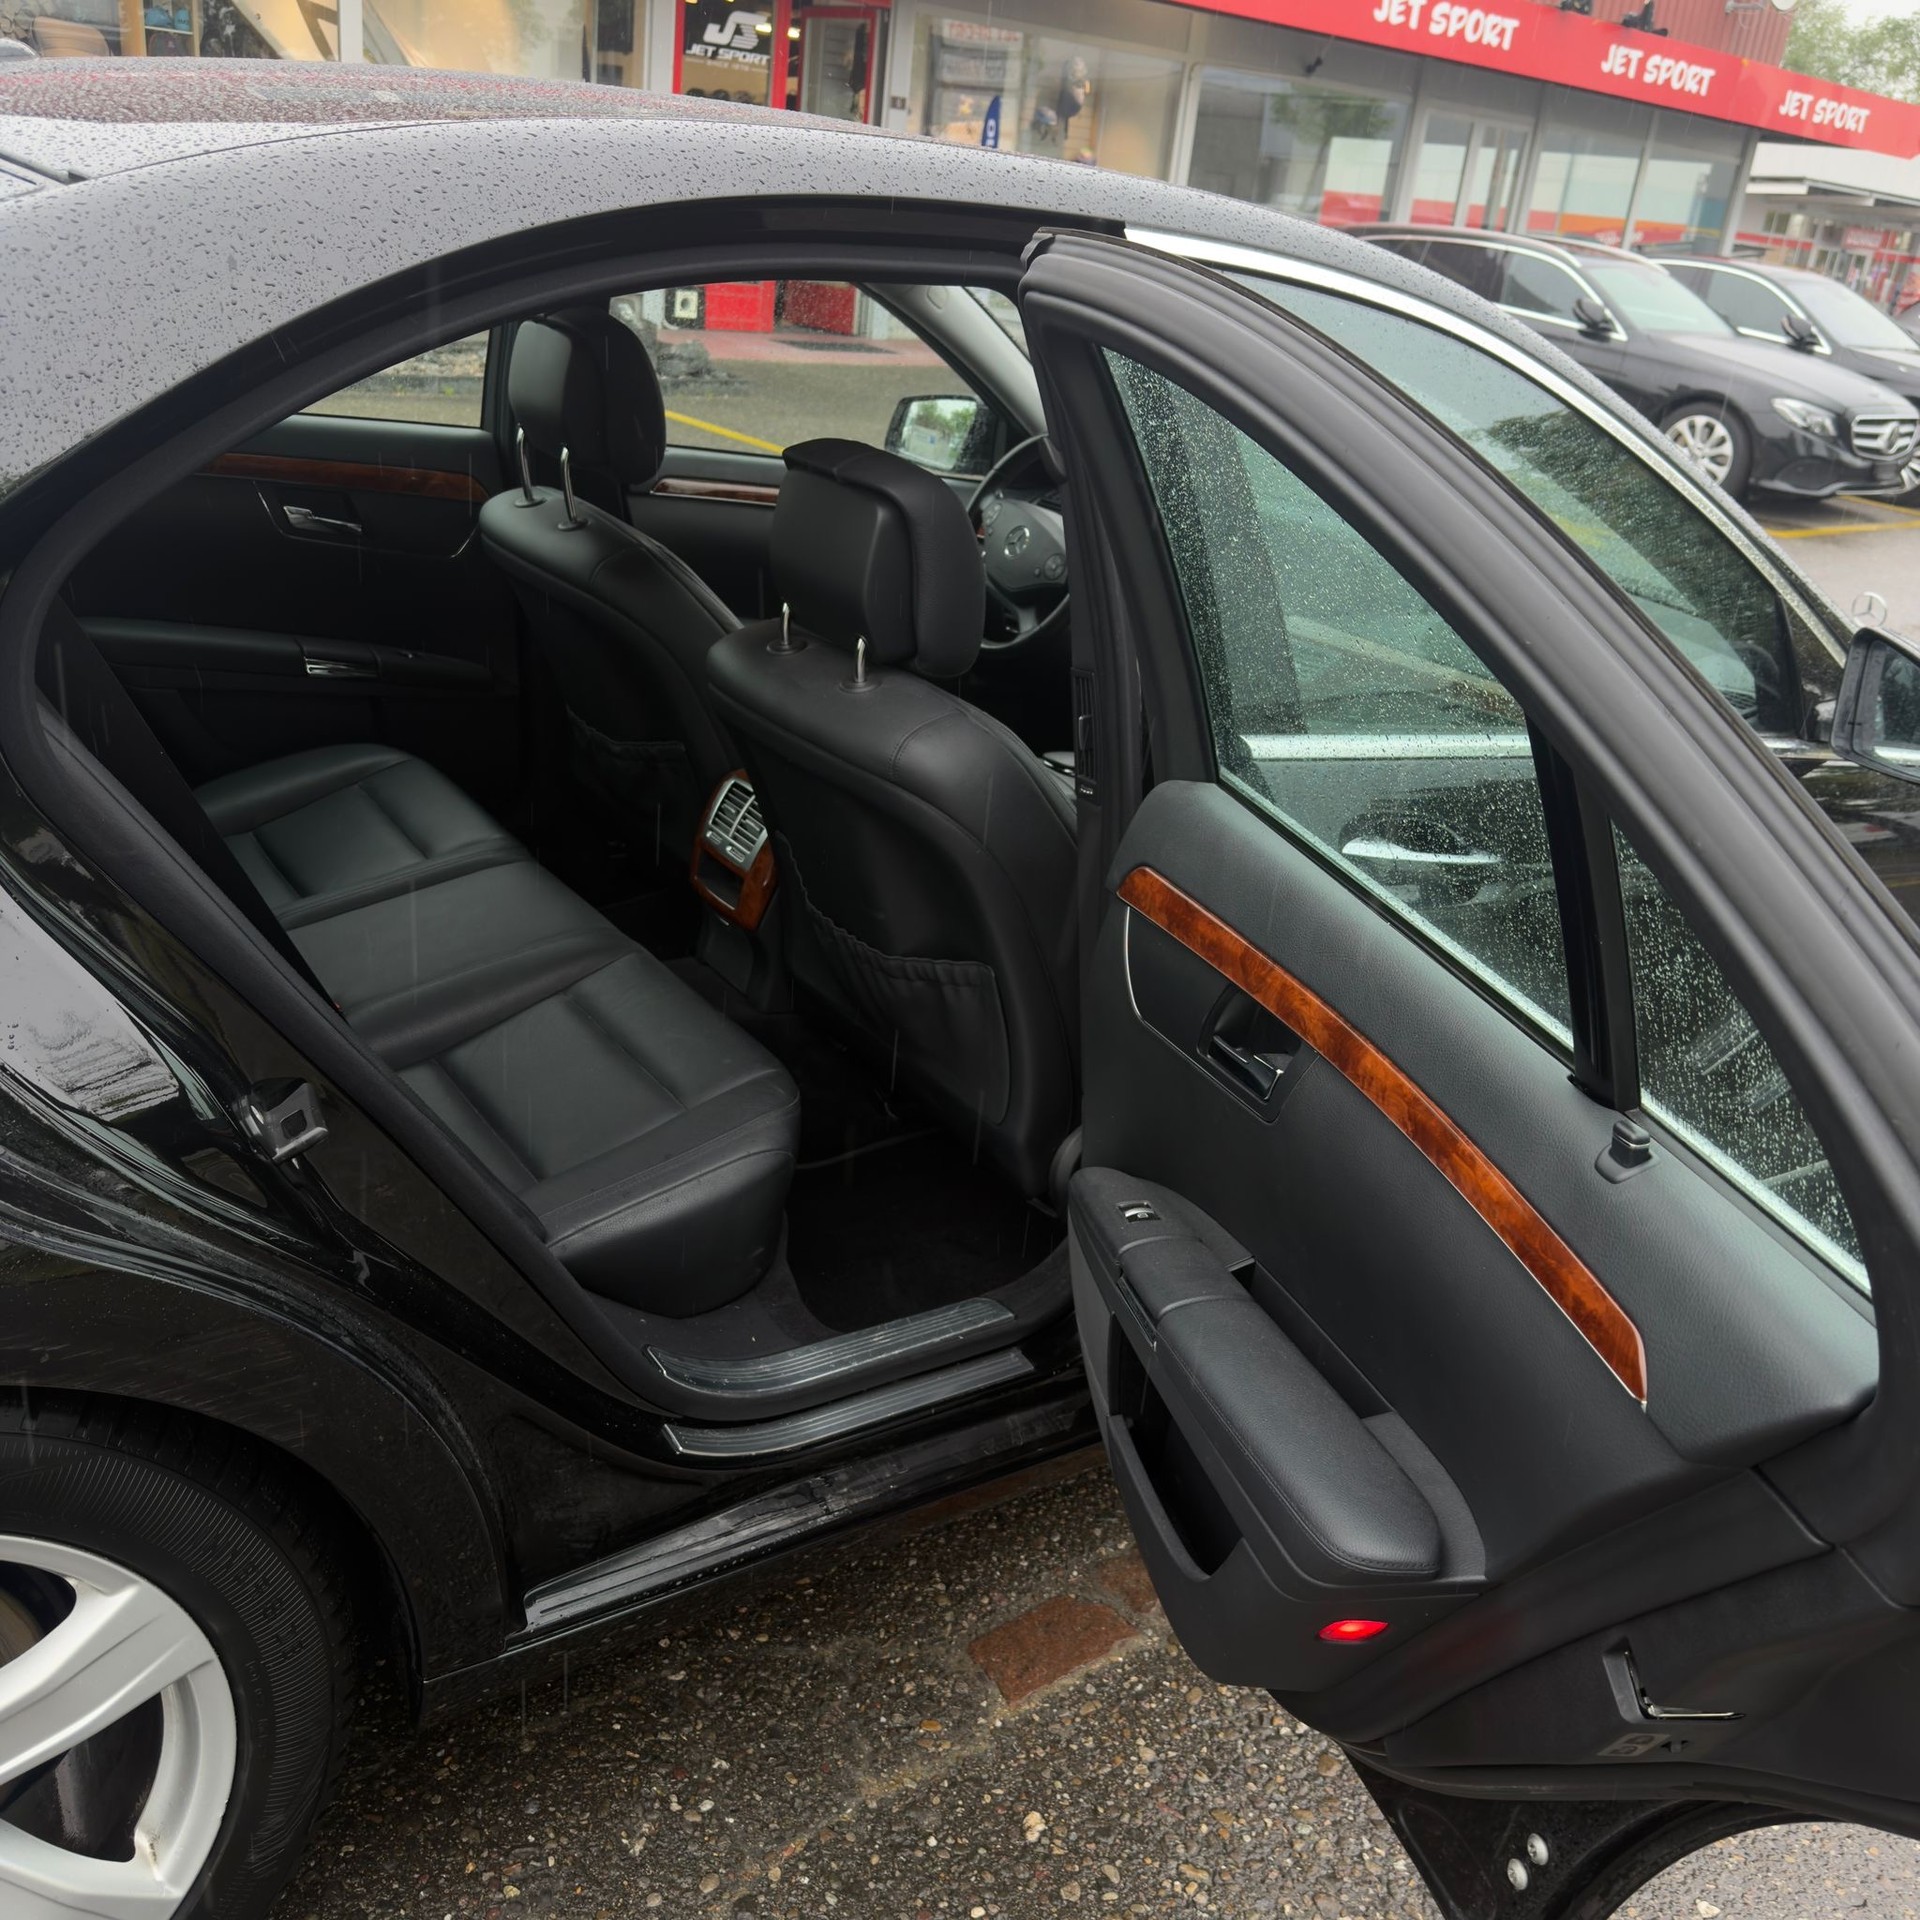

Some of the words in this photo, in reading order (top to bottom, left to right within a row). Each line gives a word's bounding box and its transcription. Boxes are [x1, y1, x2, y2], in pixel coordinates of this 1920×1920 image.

[1373, 0, 1427, 30] JET
[1429, 1, 1520, 51] SPORT
[685, 43, 717, 58] JET
[717, 47, 771, 65] SPORT
[1600, 43, 1644, 80] JET
[1642, 53, 1716, 97] SPORT
[1779, 89, 1814, 121] JET
[1812, 97, 1870, 134] SPORT
